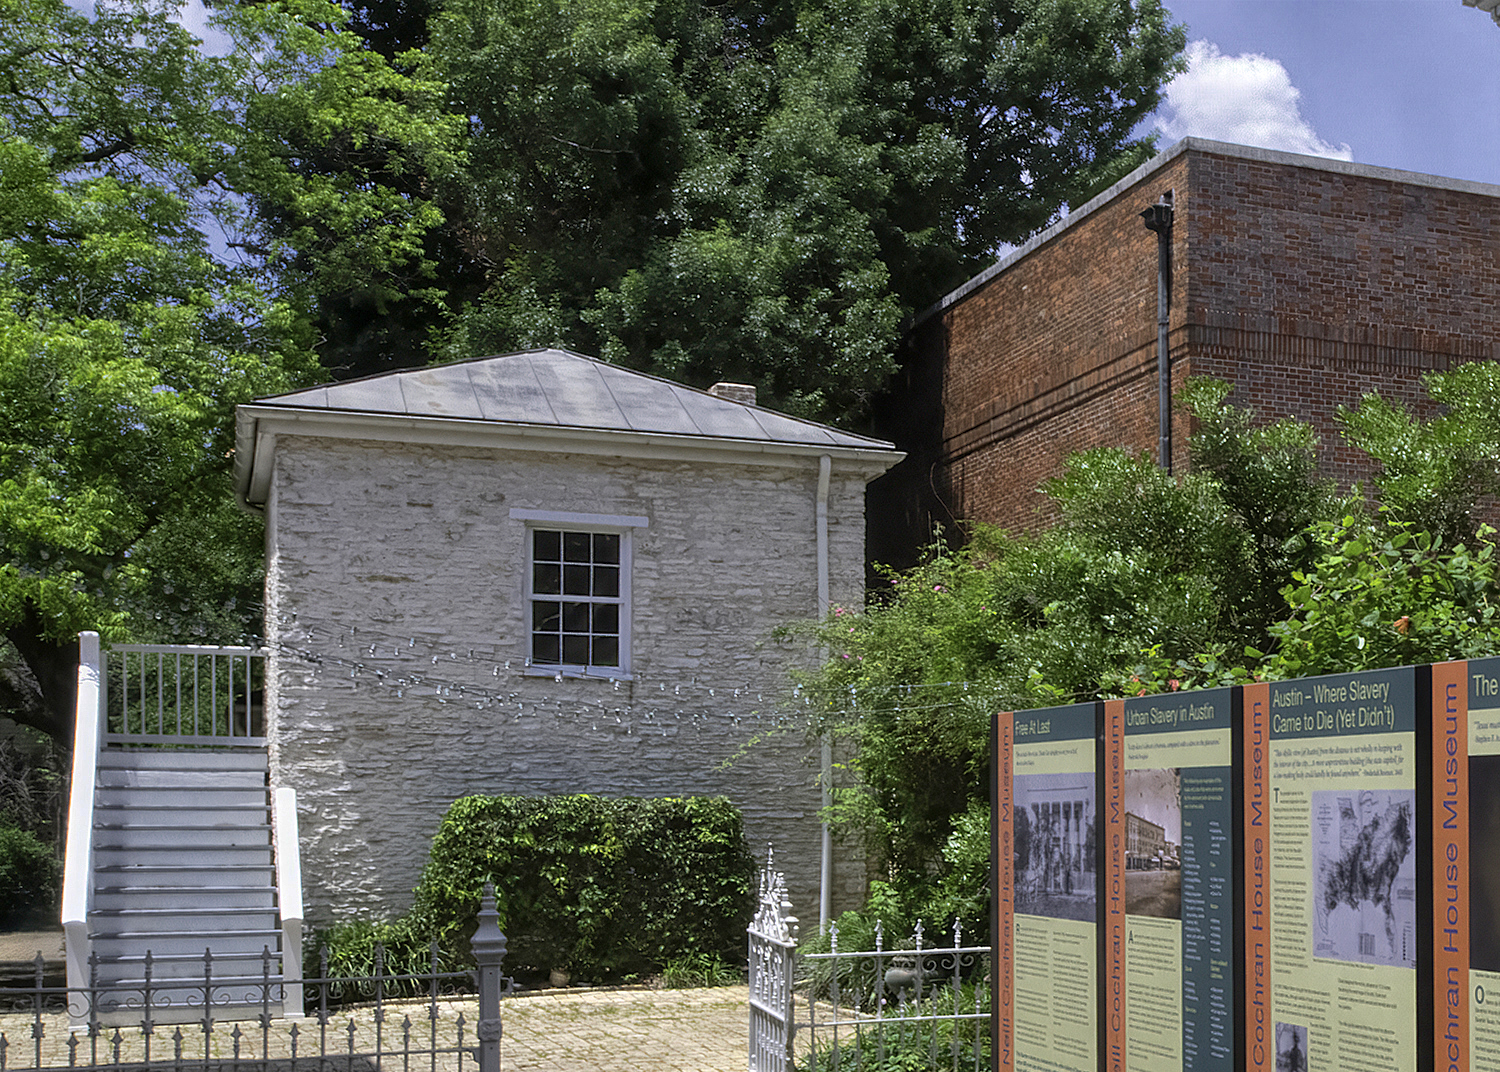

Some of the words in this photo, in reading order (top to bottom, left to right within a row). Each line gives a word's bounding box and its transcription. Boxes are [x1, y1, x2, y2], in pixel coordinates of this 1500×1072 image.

[1014, 720, 1028, 735] Free
[1029, 719, 1036, 734] At
[1036, 719, 1050, 734] Last
[1126, 710, 1148, 726] Urban
[1150, 707, 1178, 726] Slavery
[1179, 704, 1187, 721] in
[1188, 702, 1214, 721] Austin
[1272, 687, 1303, 707] Austin
[1313, 684, 1347, 703] Where
[1349, 680, 1390, 703] Slavery
[1273, 714, 1302, 733] Came
[1303, 713, 1314, 731] to
[1316, 710, 1333, 730] Die
[1336, 708, 1356, 733] (Yet
[1472, 674, 1498, 695] The
[1110, 716, 1120, 824] Museum
[1252, 702, 1262, 826] Museum
[1442, 684, 1458, 830] Museum
[1110, 834, 1120, 914] House
[1252, 838, 1264, 930] House
[1444, 842, 1458, 952] House
[1002, 912, 1010, 1064] Neill-Cochran
